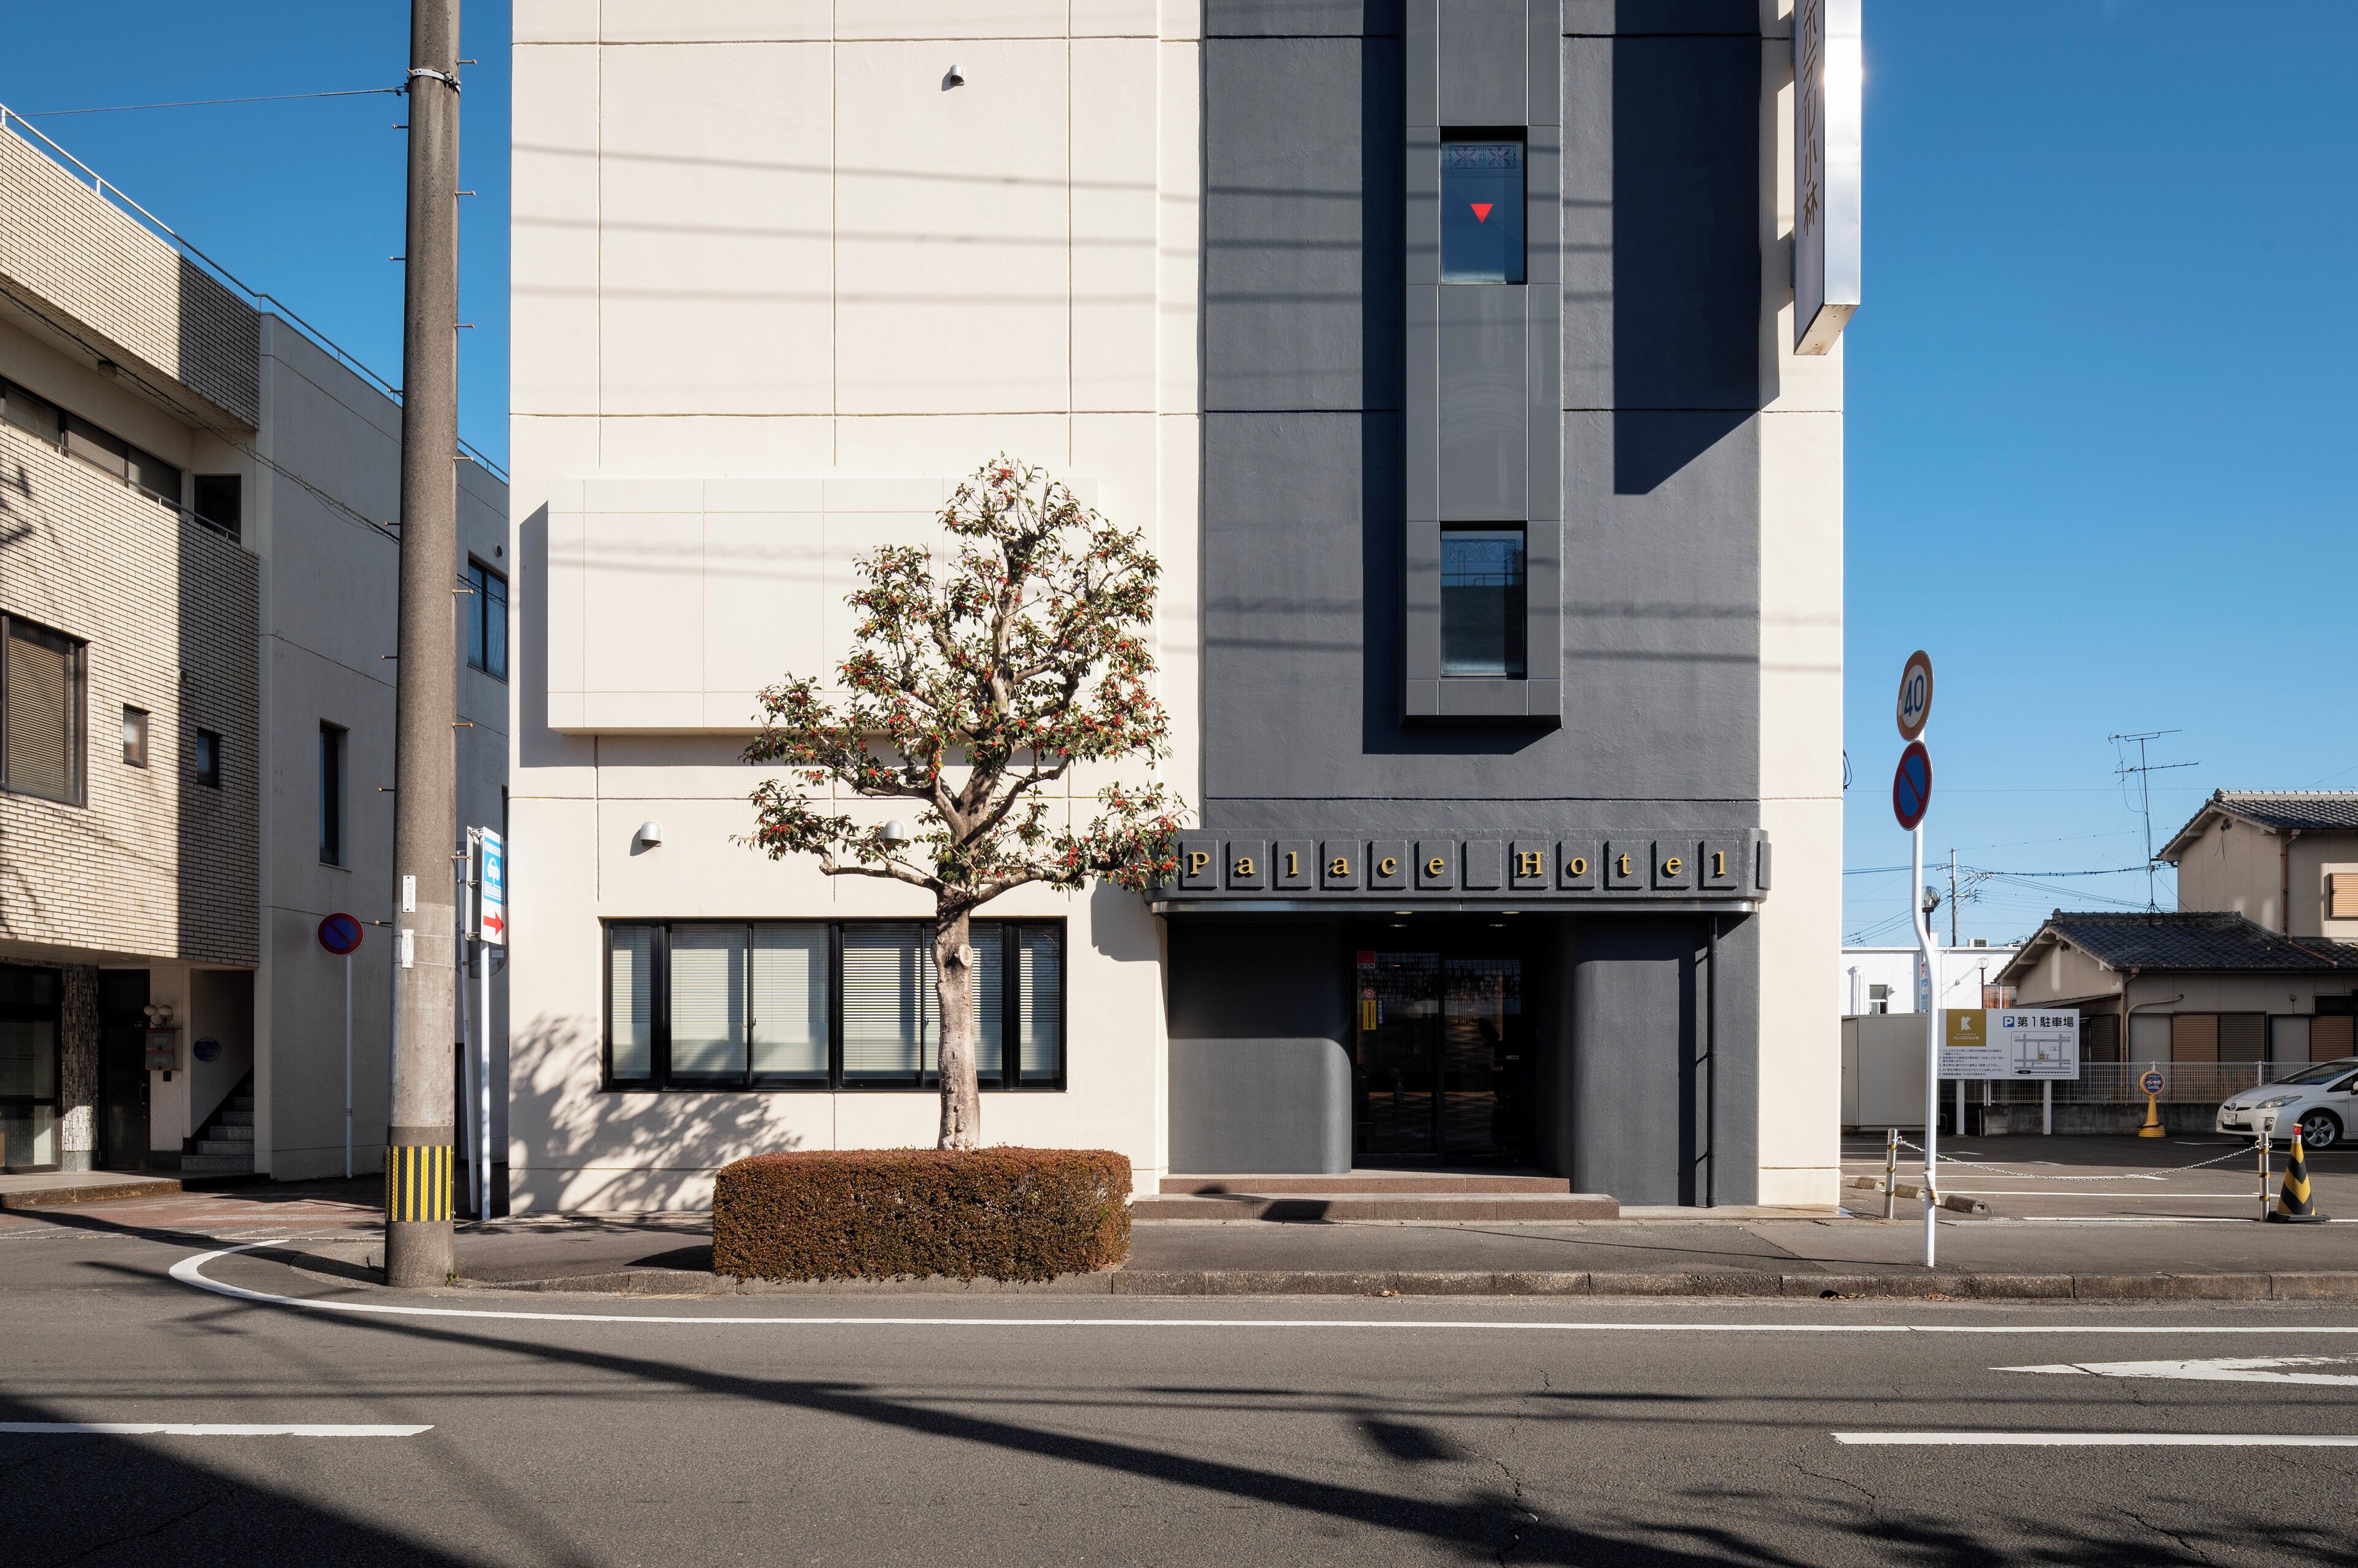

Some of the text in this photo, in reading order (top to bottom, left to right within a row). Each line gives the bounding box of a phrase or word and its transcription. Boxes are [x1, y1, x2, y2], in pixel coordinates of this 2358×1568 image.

[1804, 0, 1818, 237] ホテル小林
[1904, 674, 1924, 717] 40
[1190, 852, 1726, 875] Palace Hotel
